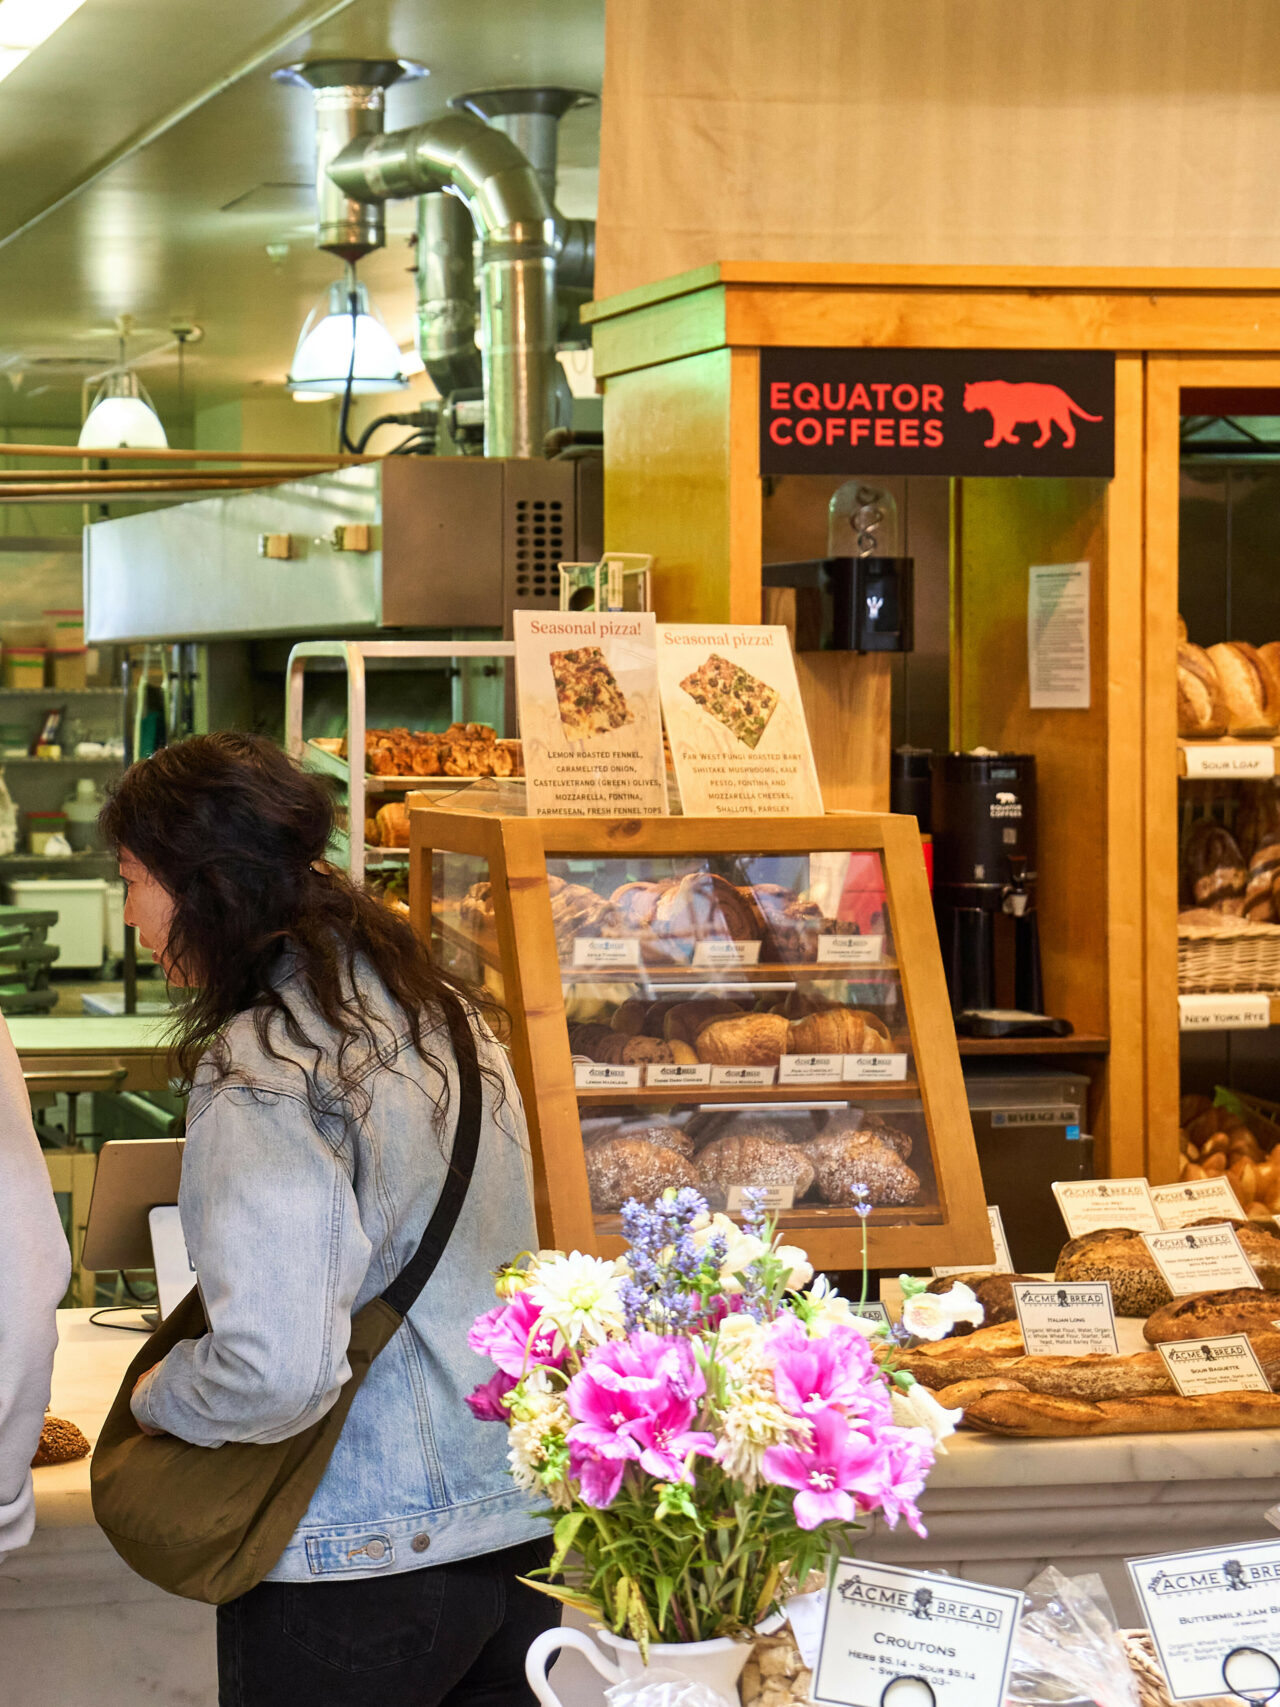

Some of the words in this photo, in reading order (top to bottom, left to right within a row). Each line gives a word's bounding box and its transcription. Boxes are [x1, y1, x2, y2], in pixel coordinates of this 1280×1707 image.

[770, 381, 945, 413] EQUATOR
[769, 416, 945, 449] COFFEES
[530, 620, 597, 636] Seasonal
[600, 621, 642, 639] pizza!
[663, 631, 729, 646] Seasonal
[733, 632, 774, 649] pizza!
[547, 751, 574, 759] LEMON
[576, 751, 611, 759] ROASTED
[612, 751, 644, 759] FENNEL,
[556, 765, 609, 773] CARAMELIZED
[610, 765, 637, 773] ONION,
[1201, 760, 1230, 770] SOUR
[1232, 760, 1260, 769] LOAF
[533, 779, 596, 787] CASTELVETRANO
[555, 793, 607, 801] MOZZARELLA,
[587, 807, 612, 815] FRESH
[613, 807, 642, 815] FENNEL
[1184, 1014, 1210, 1024] NEW
[1213, 1013, 1240, 1022] YORK
[1243, 1011, 1265, 1021] RYE
[1027, 1294, 1056, 1303] ACME
[1070, 1294, 1102, 1303] BREAD
[1174, 1351, 1203, 1361] ACME
[1213, 1346, 1244, 1357] BREAD
[1208, 1365, 1240, 1373] BAGUETTE
[1162, 1572, 1221, 1591] ACME
[1250, 1563, 1280, 1580] BRE
[850, 1585, 909, 1607] ACME
[937, 1601, 999, 1624] BREAD
[1178, 1611, 1243, 1625] BUTTERMILK
[1246, 1608, 1268, 1617] JAM
[873, 1632, 956, 1658] CROUTONS
[848, 1649, 876, 1662] HERB
[879, 1655, 907, 1668] $5.14
[918, 1663, 945, 1675] SOUR
[948, 1667, 976, 1680] $5.14
